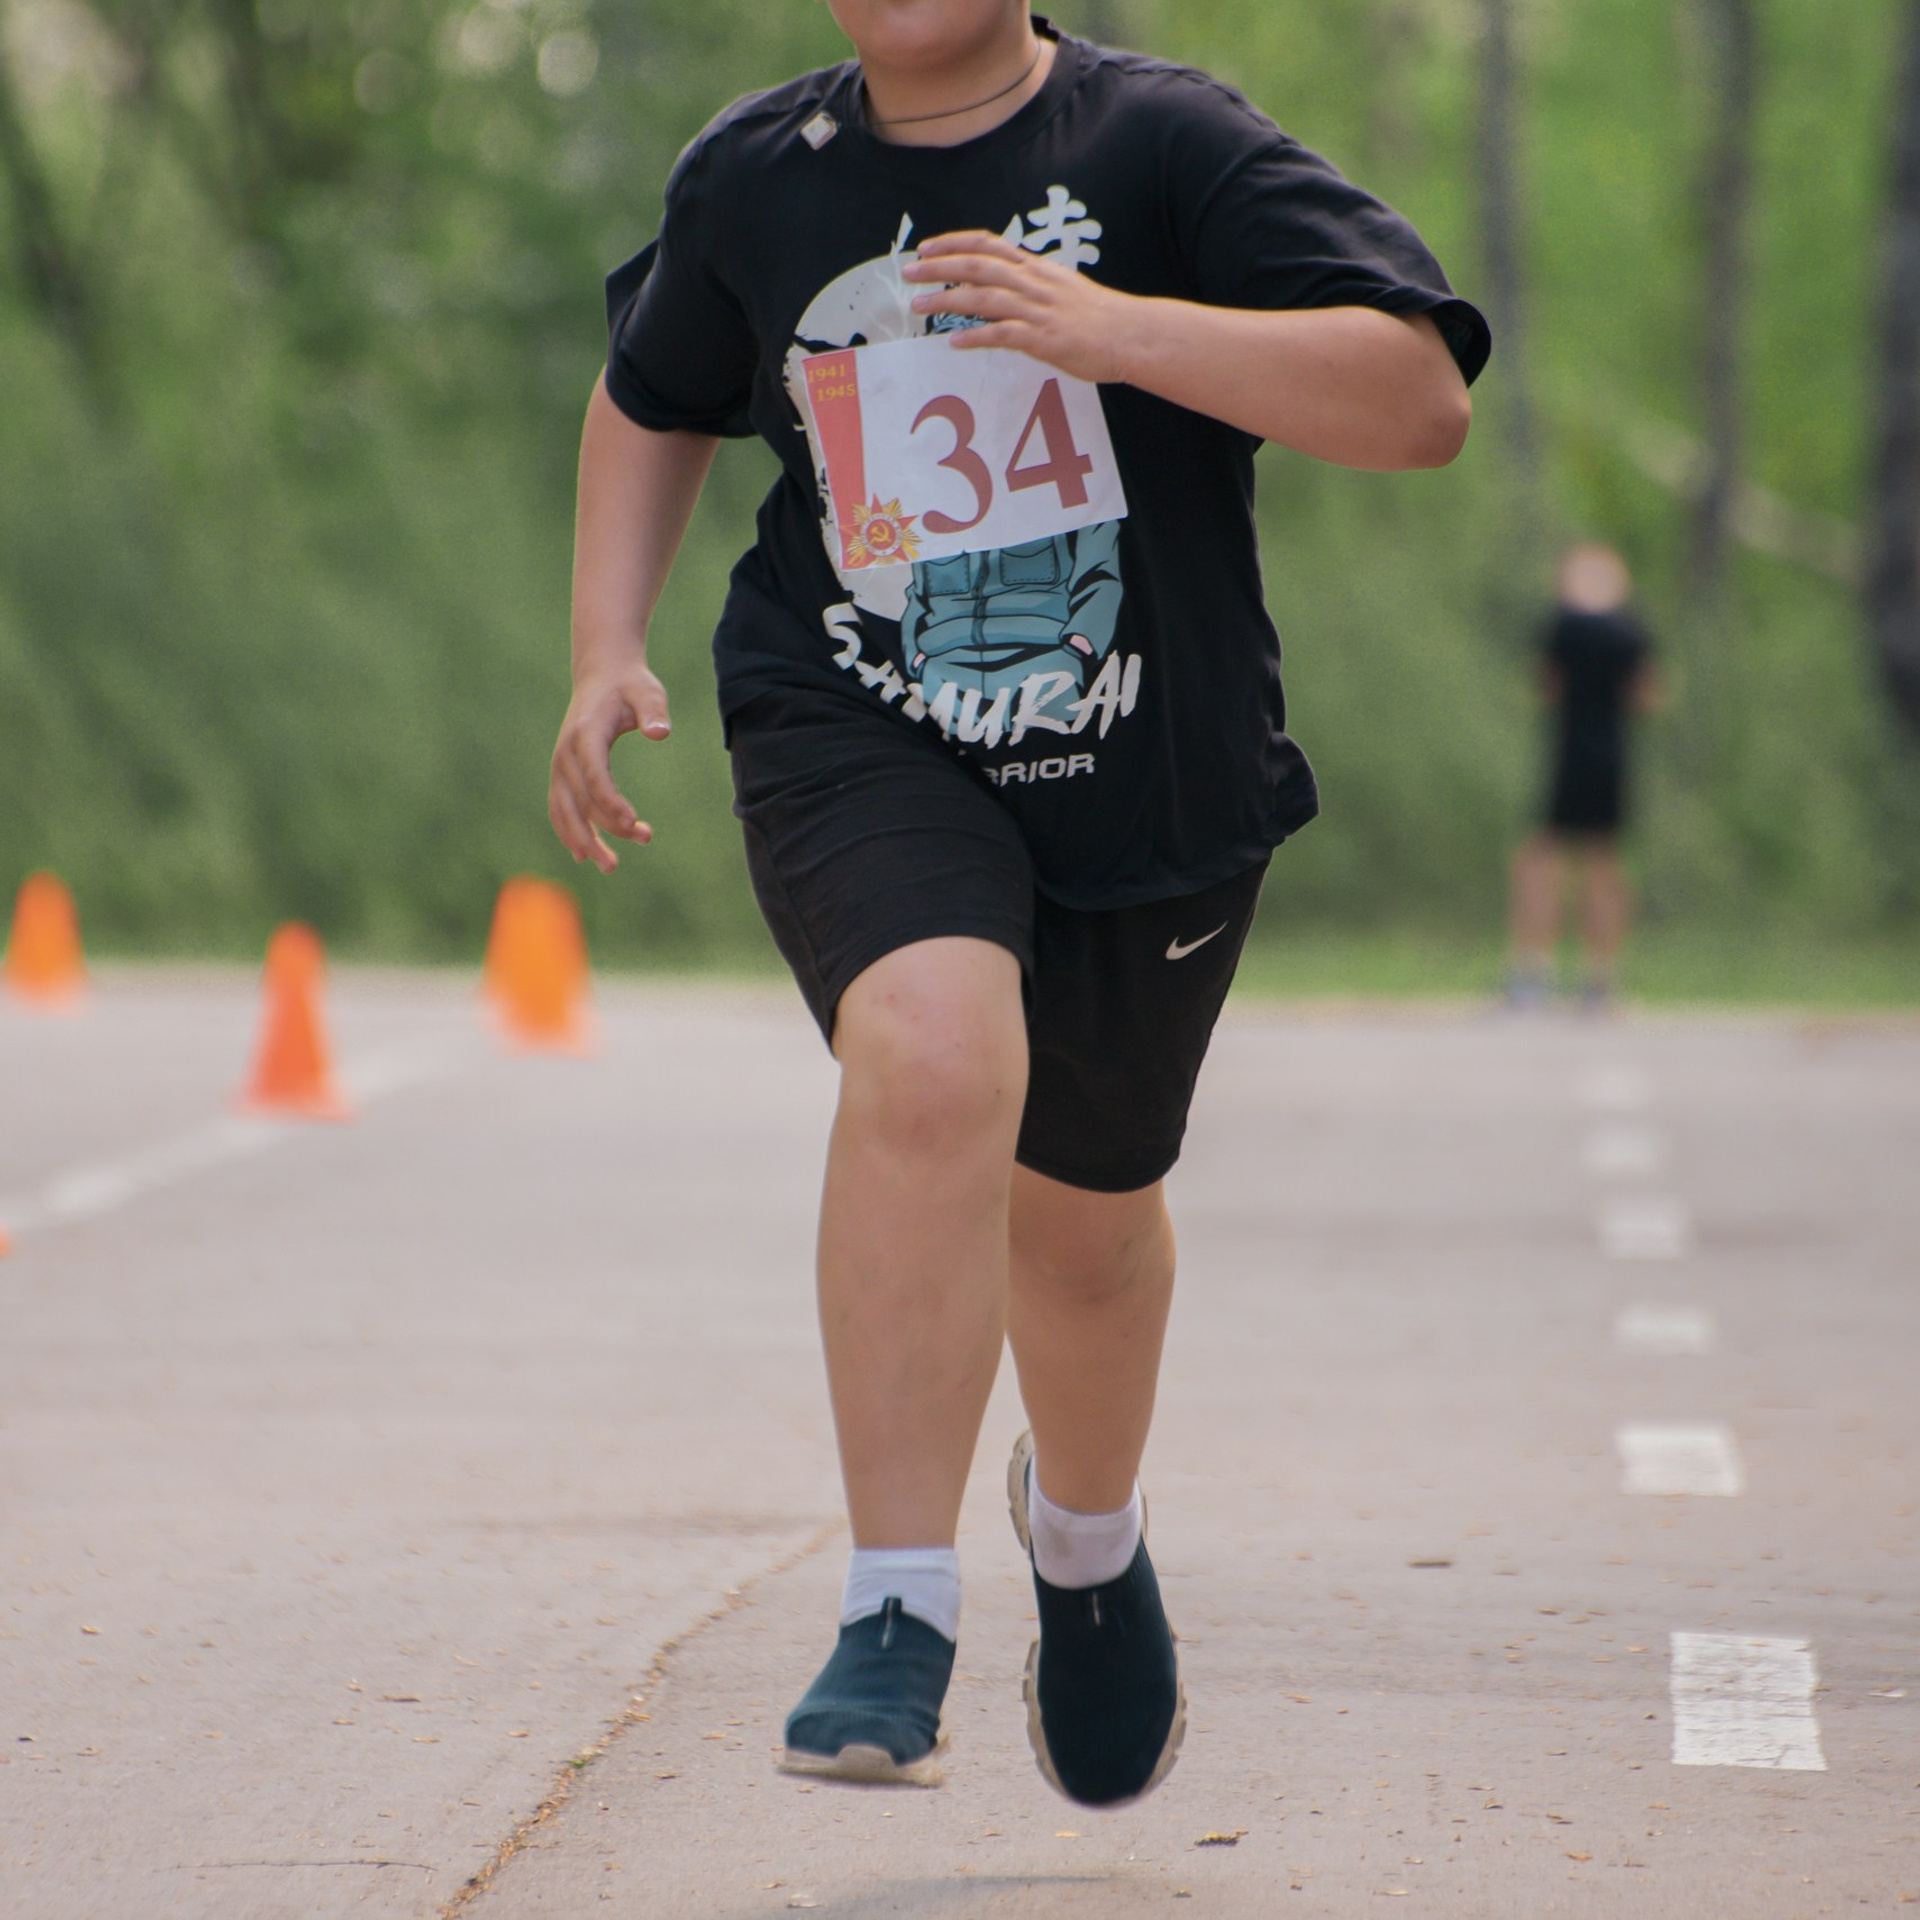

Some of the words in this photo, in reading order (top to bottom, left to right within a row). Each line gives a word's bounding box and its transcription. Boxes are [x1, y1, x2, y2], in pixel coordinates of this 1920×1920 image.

[808, 364, 846, 385] 1941
[817, 383, 857, 402] 1945
[910, 377, 1094, 535] 34
